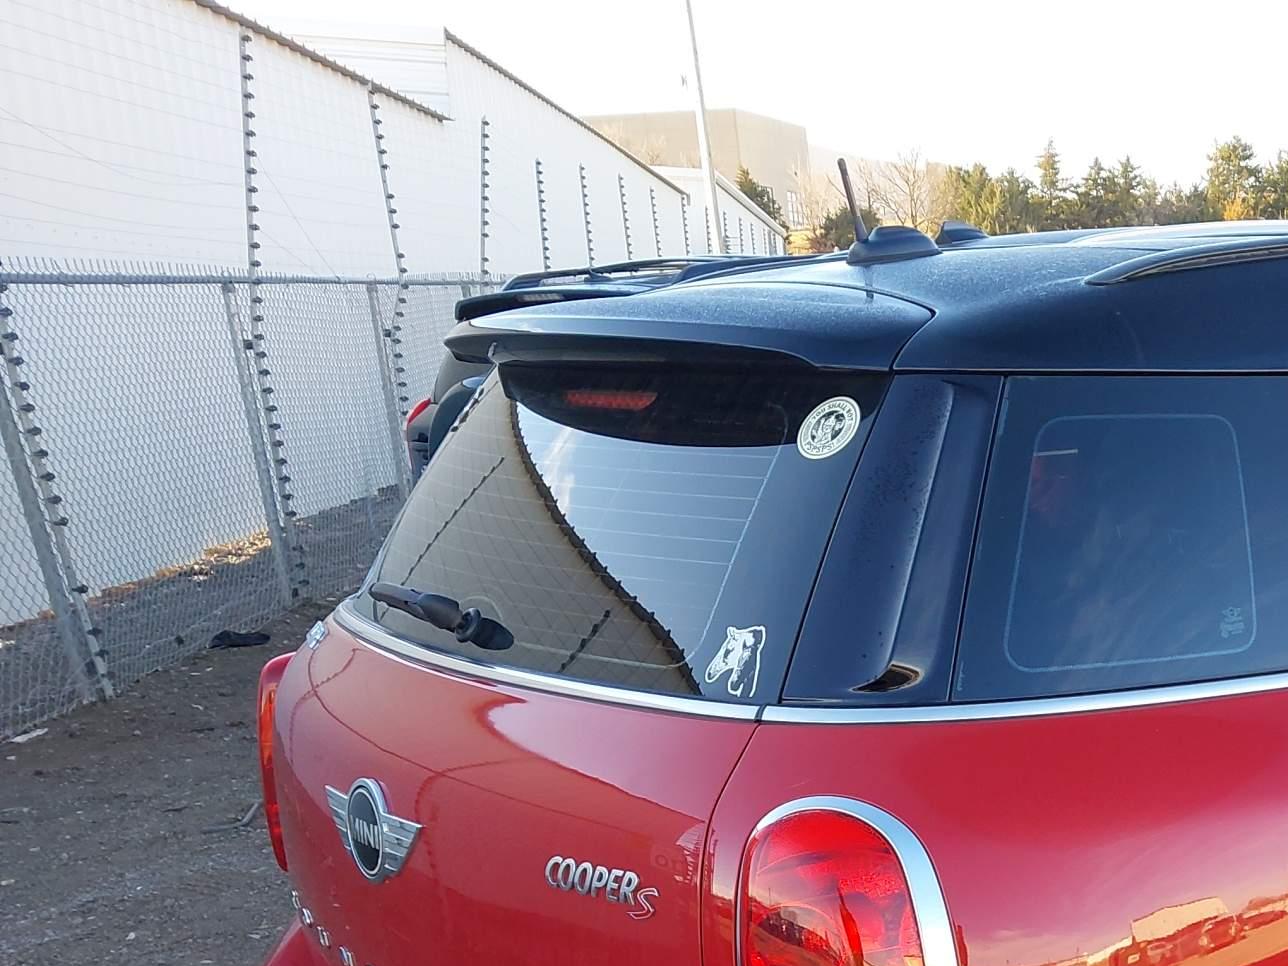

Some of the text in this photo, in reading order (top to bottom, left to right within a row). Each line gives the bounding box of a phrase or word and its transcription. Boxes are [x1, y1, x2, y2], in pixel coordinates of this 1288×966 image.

[350, 814, 380, 850] MINI
[545, 855, 659, 920] COOPER S
